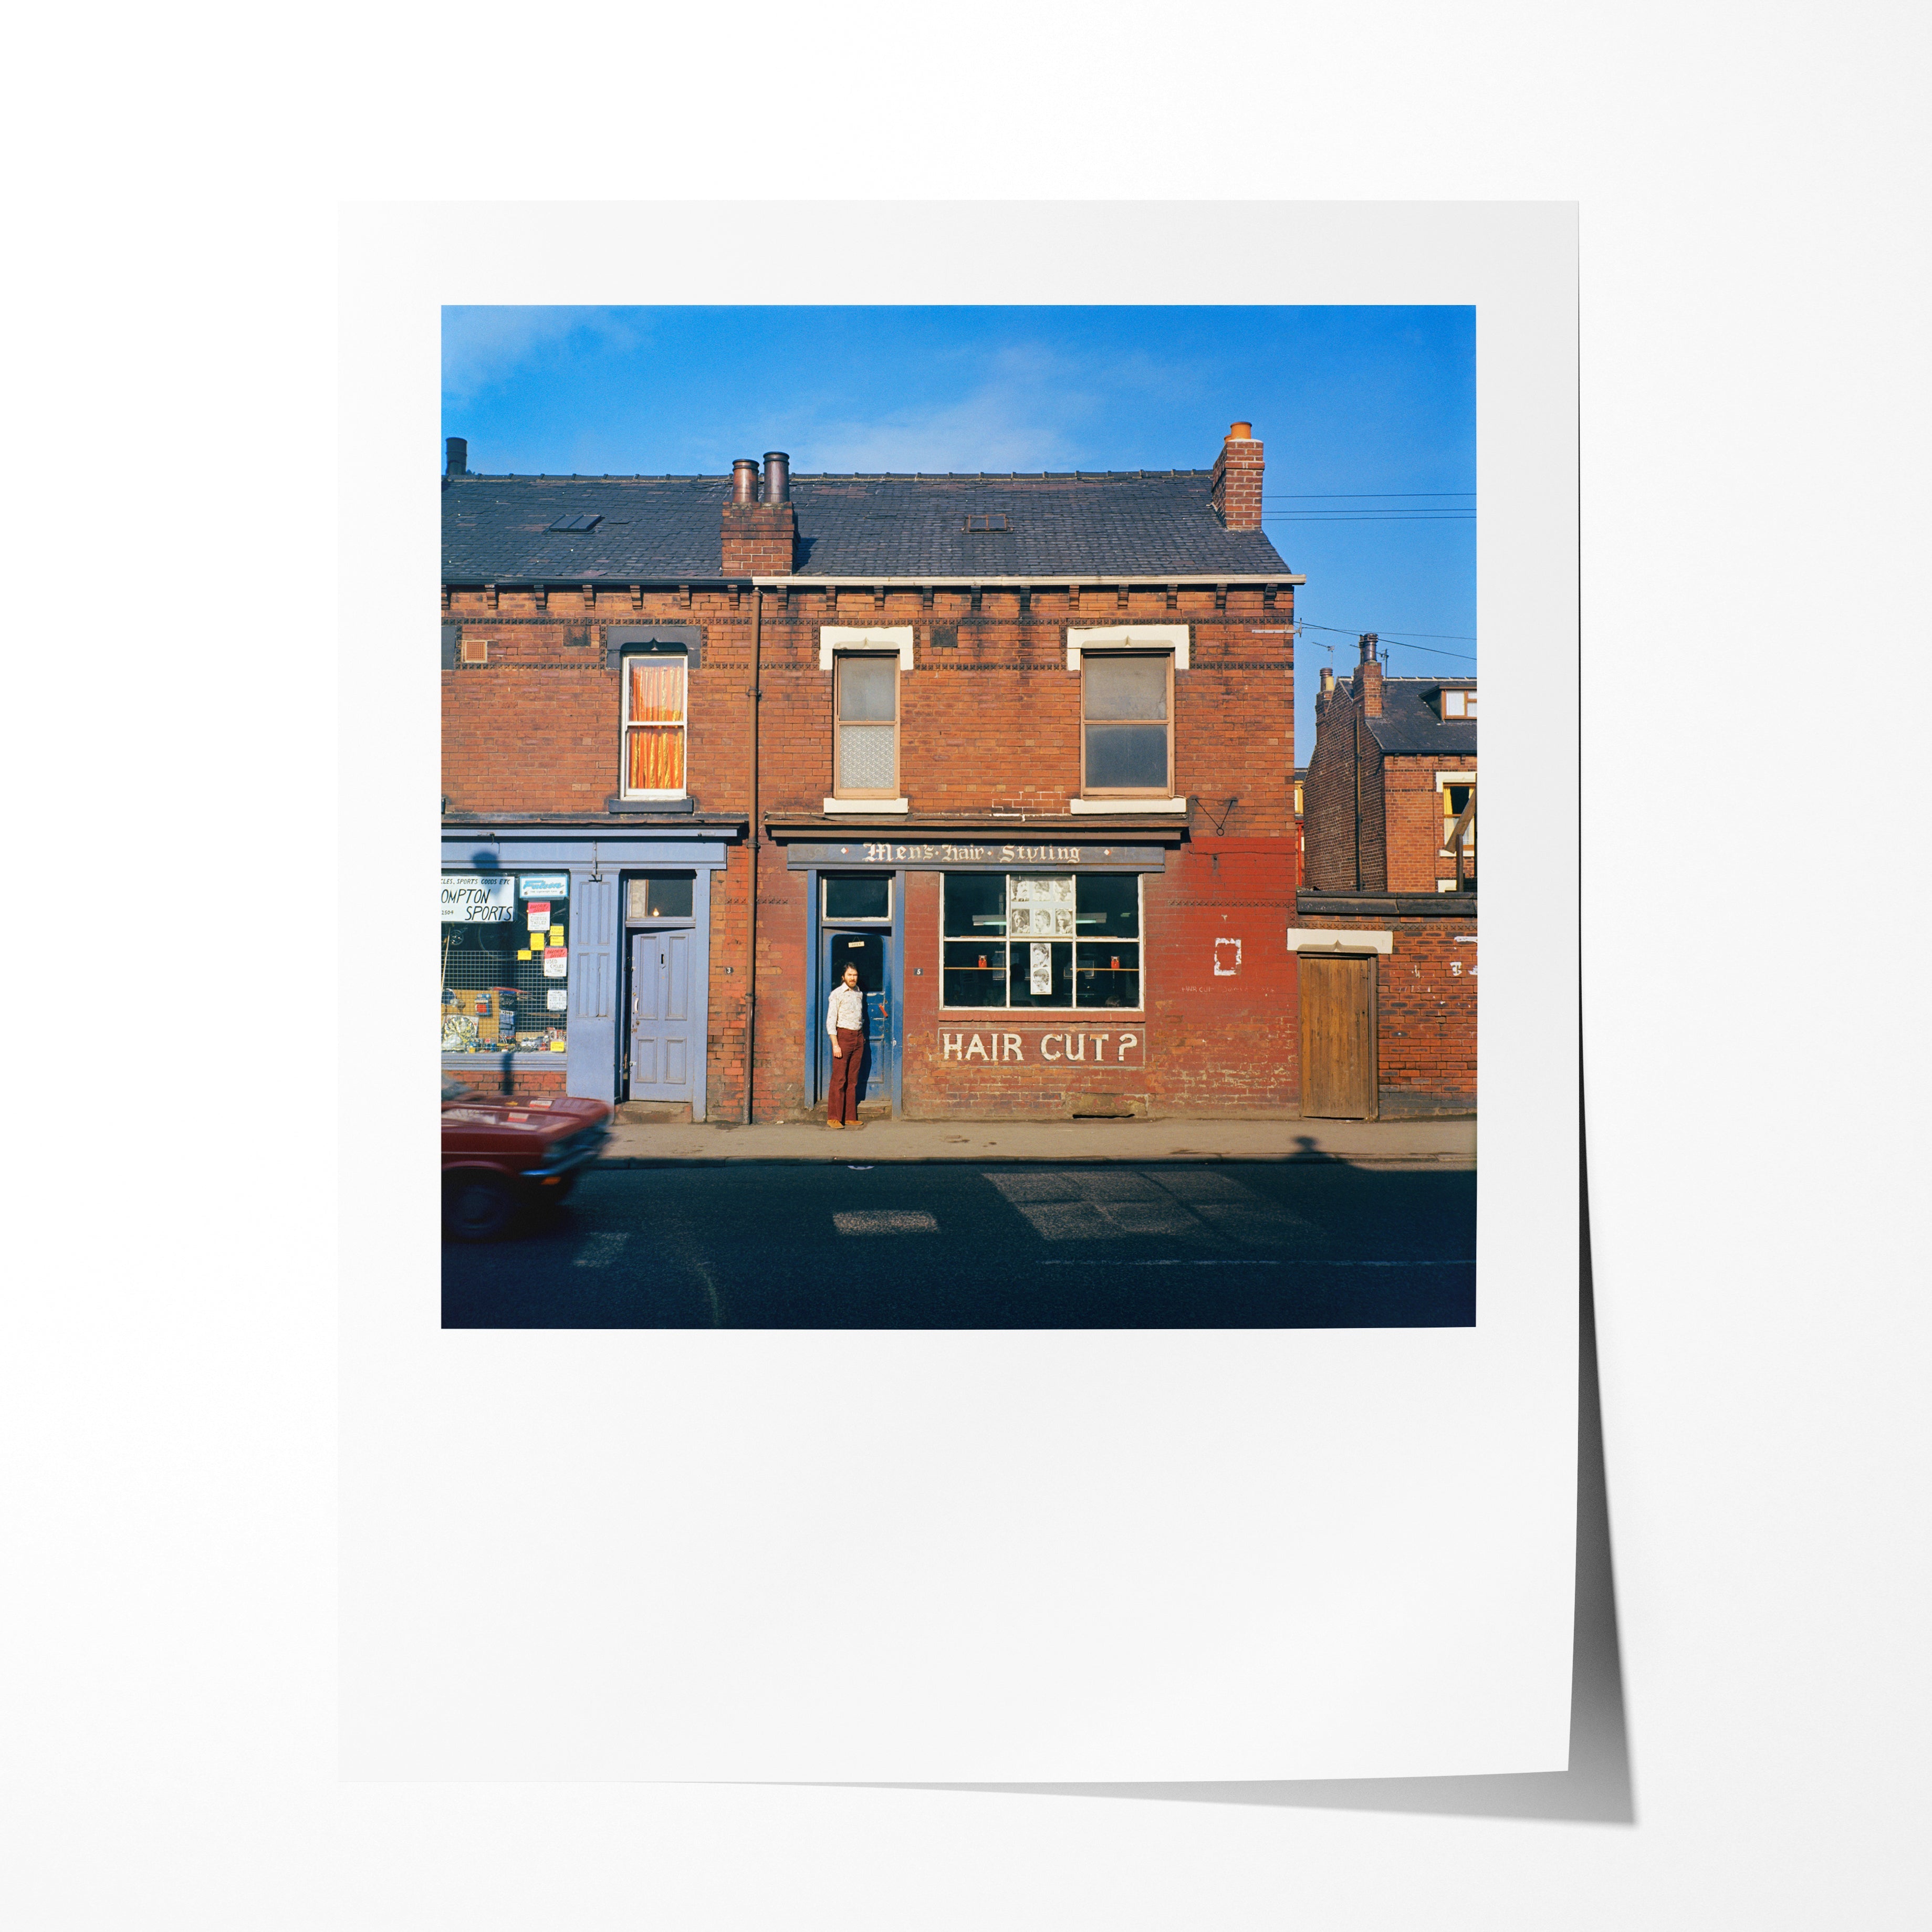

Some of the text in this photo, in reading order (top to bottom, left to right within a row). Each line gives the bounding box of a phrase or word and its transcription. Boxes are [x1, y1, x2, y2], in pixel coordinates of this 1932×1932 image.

[862, 842, 934, 862] Men's
[998, 843, 1081, 863] Styling
[464, 906, 513, 921] SPORTS
[943, 1033, 1025, 1061] HAIR
